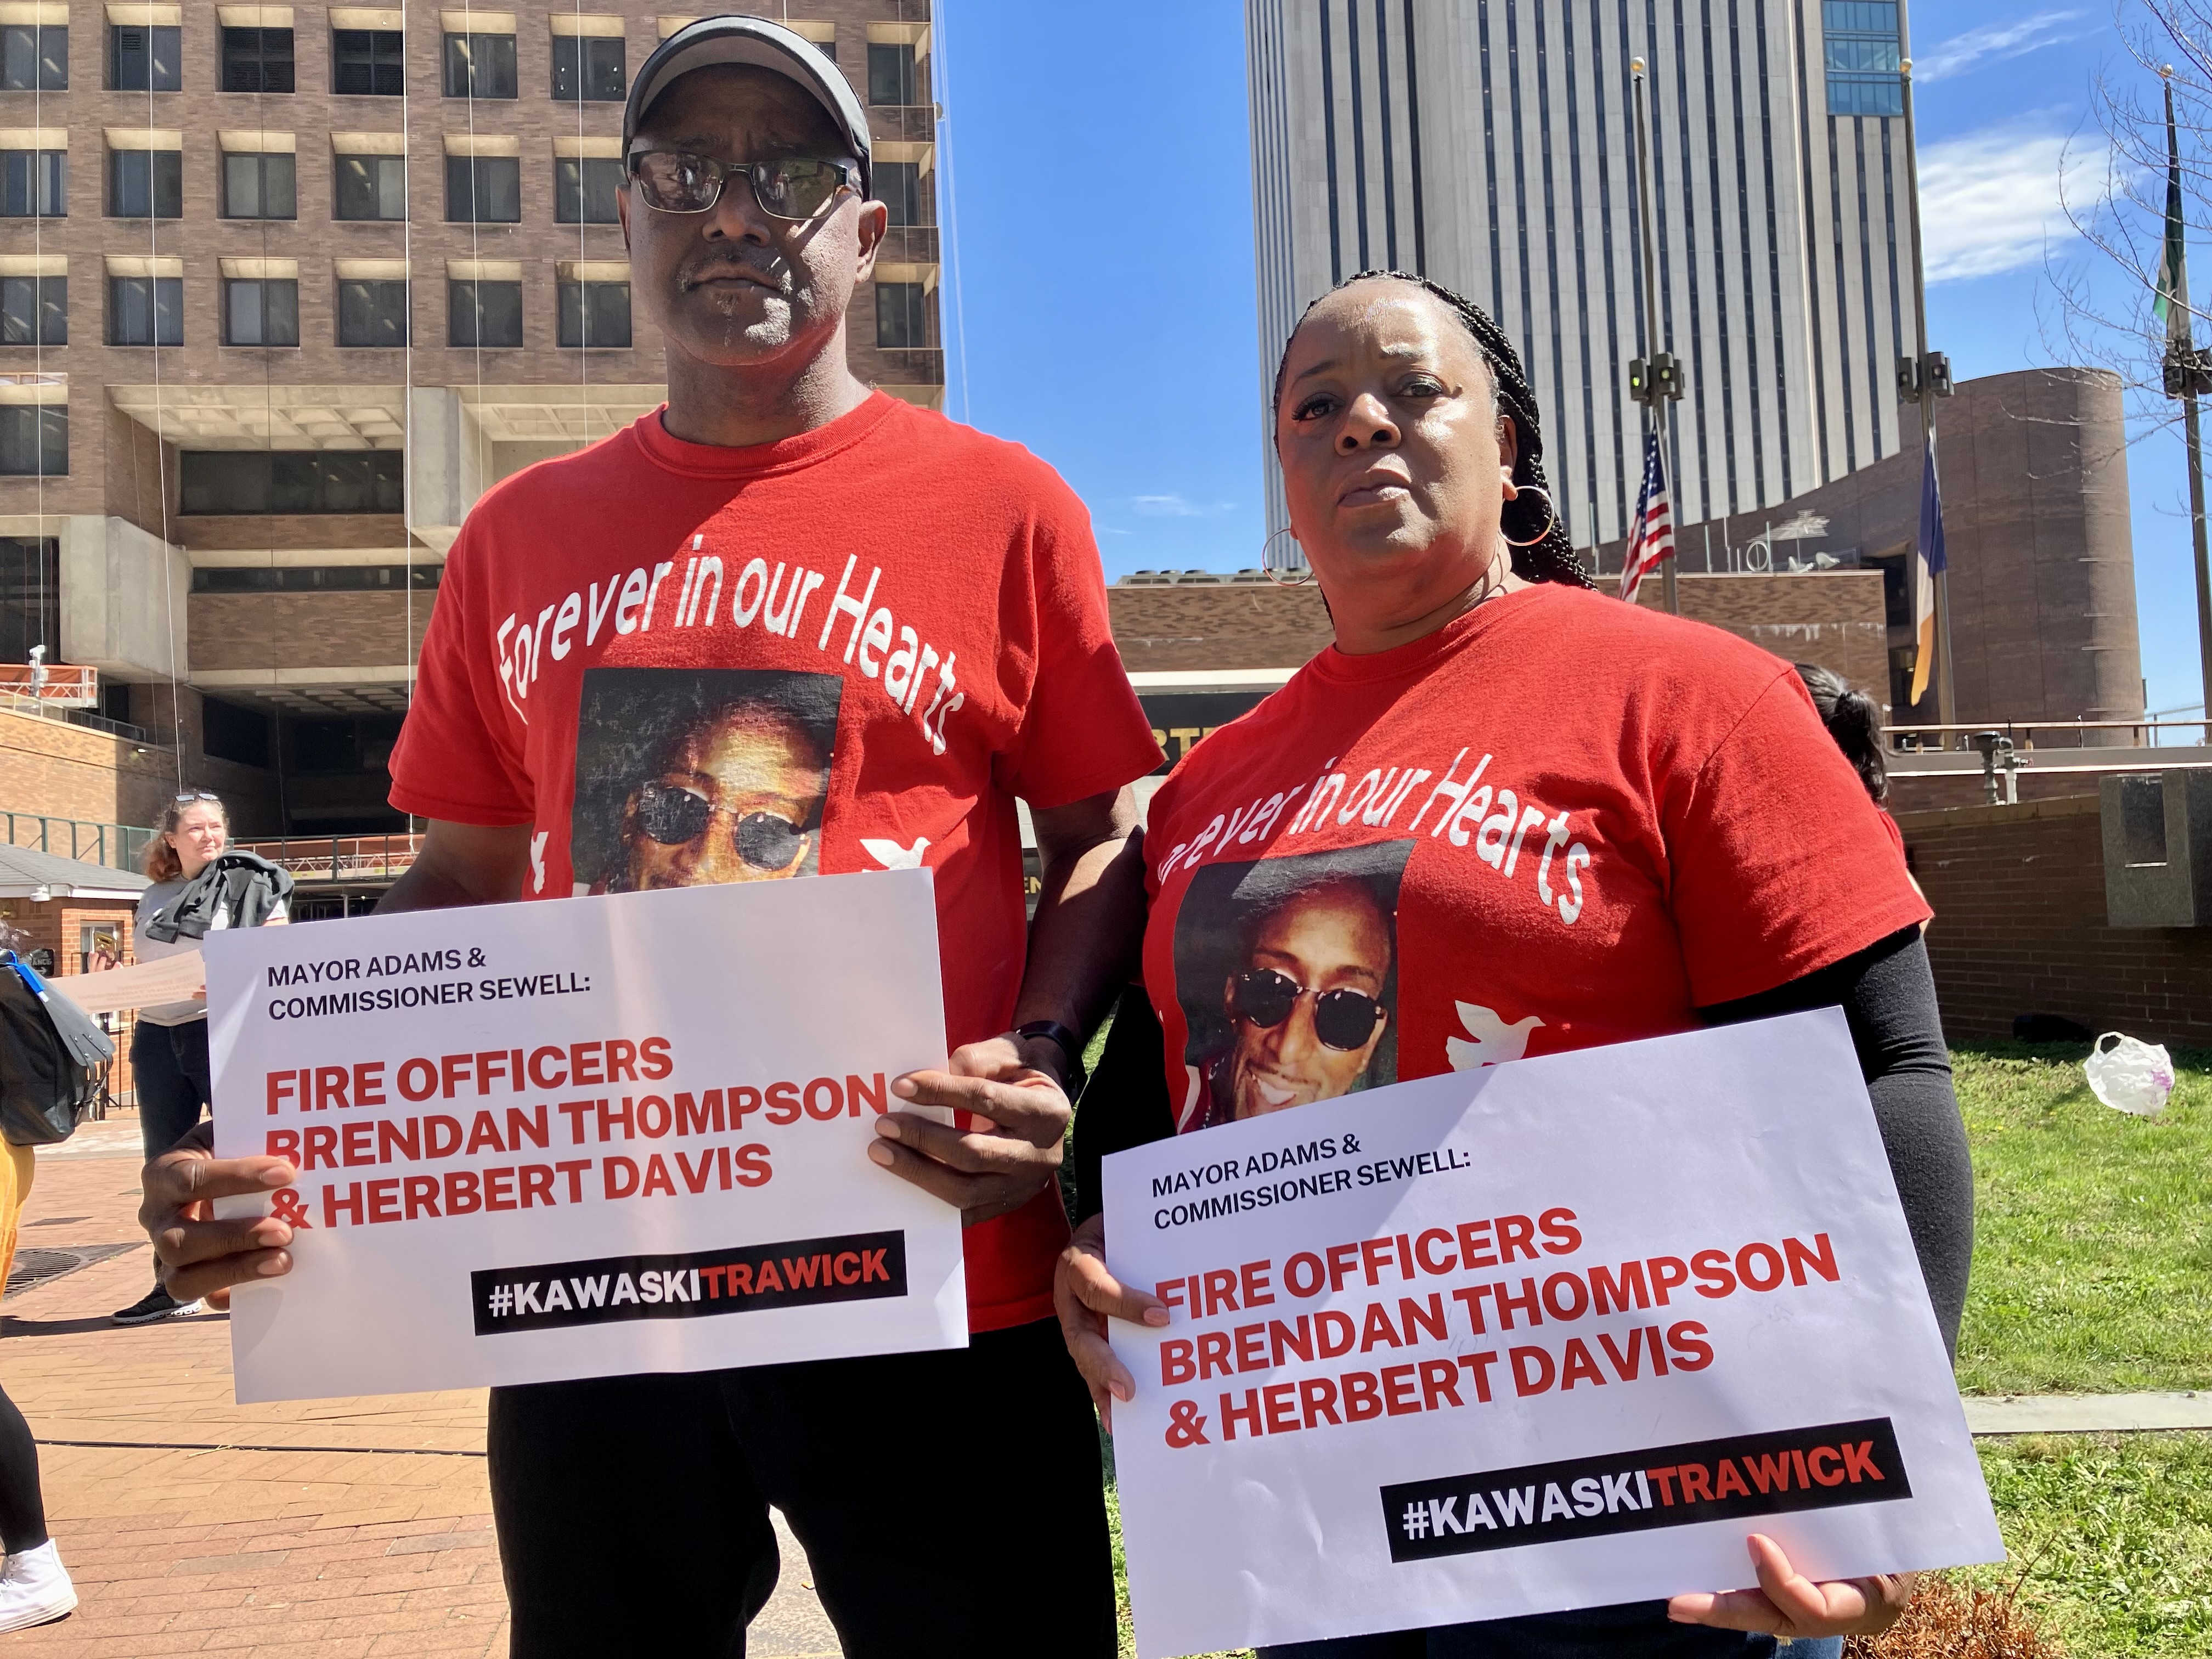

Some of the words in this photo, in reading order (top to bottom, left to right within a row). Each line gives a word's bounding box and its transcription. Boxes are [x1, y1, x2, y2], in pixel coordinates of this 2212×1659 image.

[497, 561, 674, 725] Forever
[674, 534, 723, 627] in
[733, 558, 825, 639] our
[819, 554, 964, 755] Hearts
[1158, 783, 1306, 885] orever
[1288, 757, 1346, 834] in
[1337, 767, 1431, 827] our
[1408, 747, 1590, 924] Hearts
[269, 960, 360, 986] MAYOR
[366, 950, 461, 977] ADAMS
[467, 947, 487, 968] &
[269, 983, 472, 1019] COMMISSIONER
[480, 973, 590, 1000] SEWELL:
[267, 1062, 386, 1115] FIRE
[397, 1037, 673, 1102] OFFICERS
[267, 1105, 549, 1171] BRENDAN
[558, 1073, 888, 1144] THOMPSON
[270, 1188, 313, 1229] &
[323, 1159, 591, 1228] HERBERT
[603, 1143, 772, 1200] DAVIS
[1153, 1161, 1239, 1197] MAYOR
[1246, 1139, 1336, 1176] ADAMS
[1342, 1133, 1362, 1154] &
[1155, 1170, 1352, 1228] COMMISSIONER
[1357, 1149, 1470, 1186] SEWELL:
[489, 1249, 889, 1317] #KAWASKITRAWICK
[1155, 1260, 1274, 1324] FIRE
[1284, 1207, 1582, 1297] OFFICERS
[1160, 1293, 1448, 1386] BRENDAN
[1452, 1233, 1839, 1334] THOMPSON
[1165, 1400, 1211, 1448] &
[1220, 1351, 1497, 1441] HERBERT
[1509, 1321, 1714, 1397] DAVIS
[1403, 1441, 1884, 1539] #KAWASKITRAWICK
